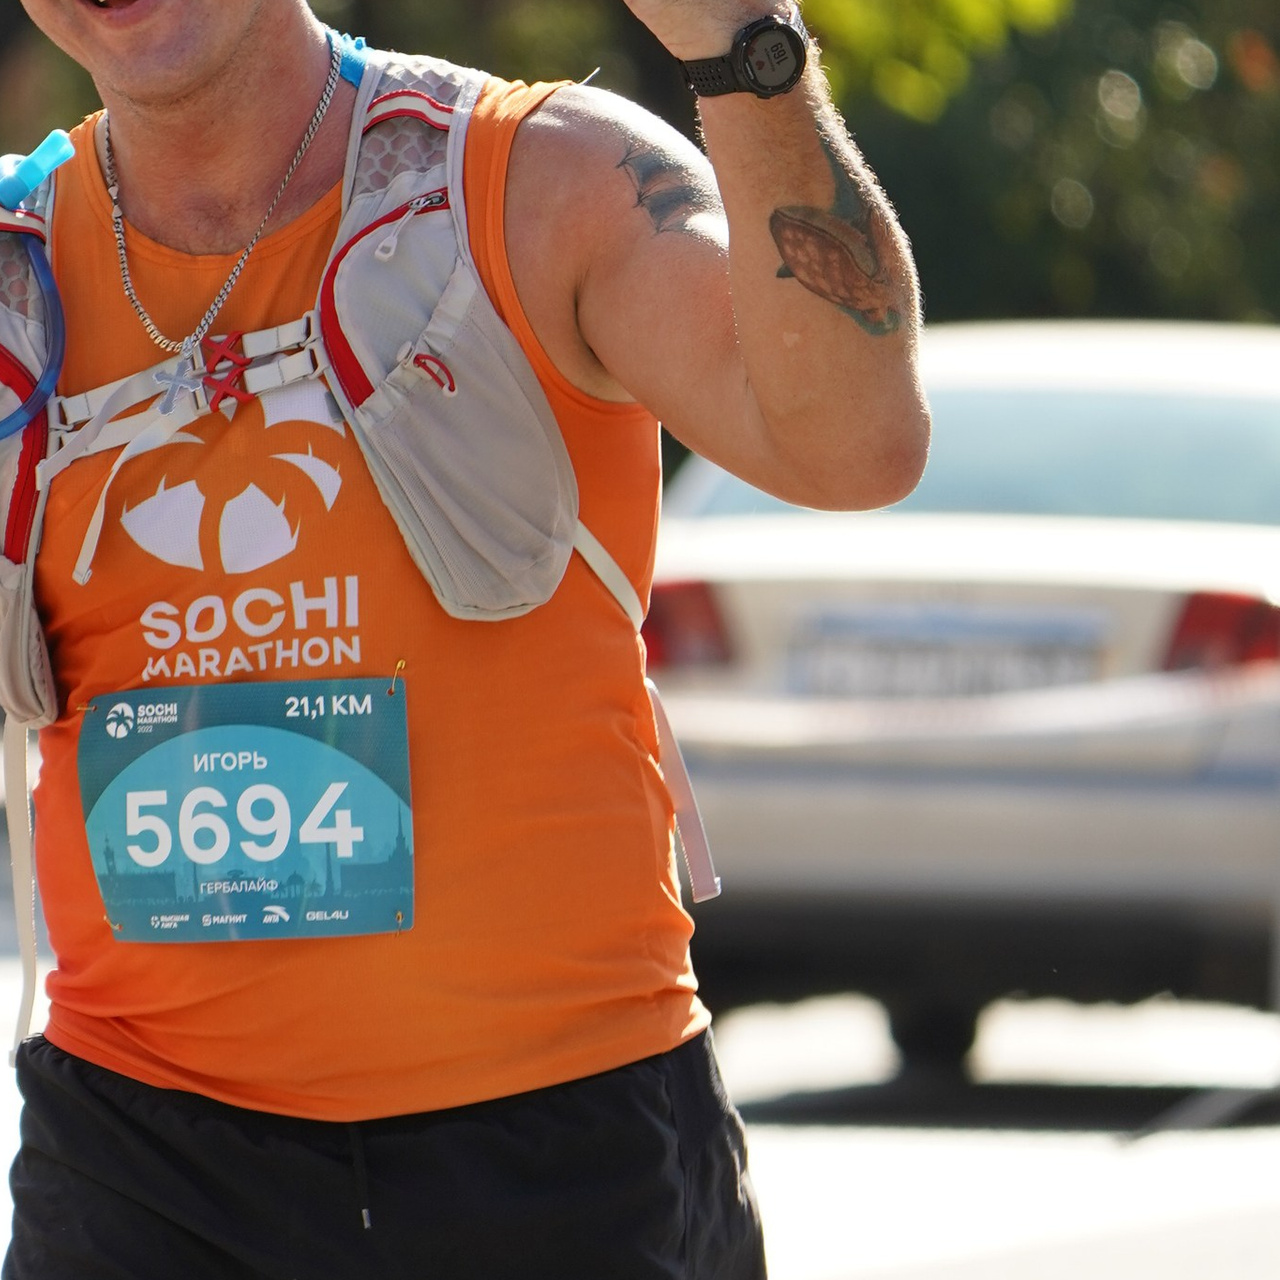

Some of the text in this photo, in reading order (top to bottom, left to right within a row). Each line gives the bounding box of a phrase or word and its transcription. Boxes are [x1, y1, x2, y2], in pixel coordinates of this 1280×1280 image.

[770, 42, 789, 65] 169
[139, 575, 359, 650] SOCHI
[141, 635, 362, 682] MARATHON
[137, 703, 178, 717] SOCHI
[284, 694, 372, 720] 21,1 KM
[136, 715, 178, 725] MARATHON
[193, 750, 268, 773] ИГОРЬ
[125, 781, 364, 868] 5694
[200, 876, 279, 895] ГЕРБАЛАЙФ
[212, 914, 248, 925] МАГНИТ
[305, 910, 349, 922] GEL4U
